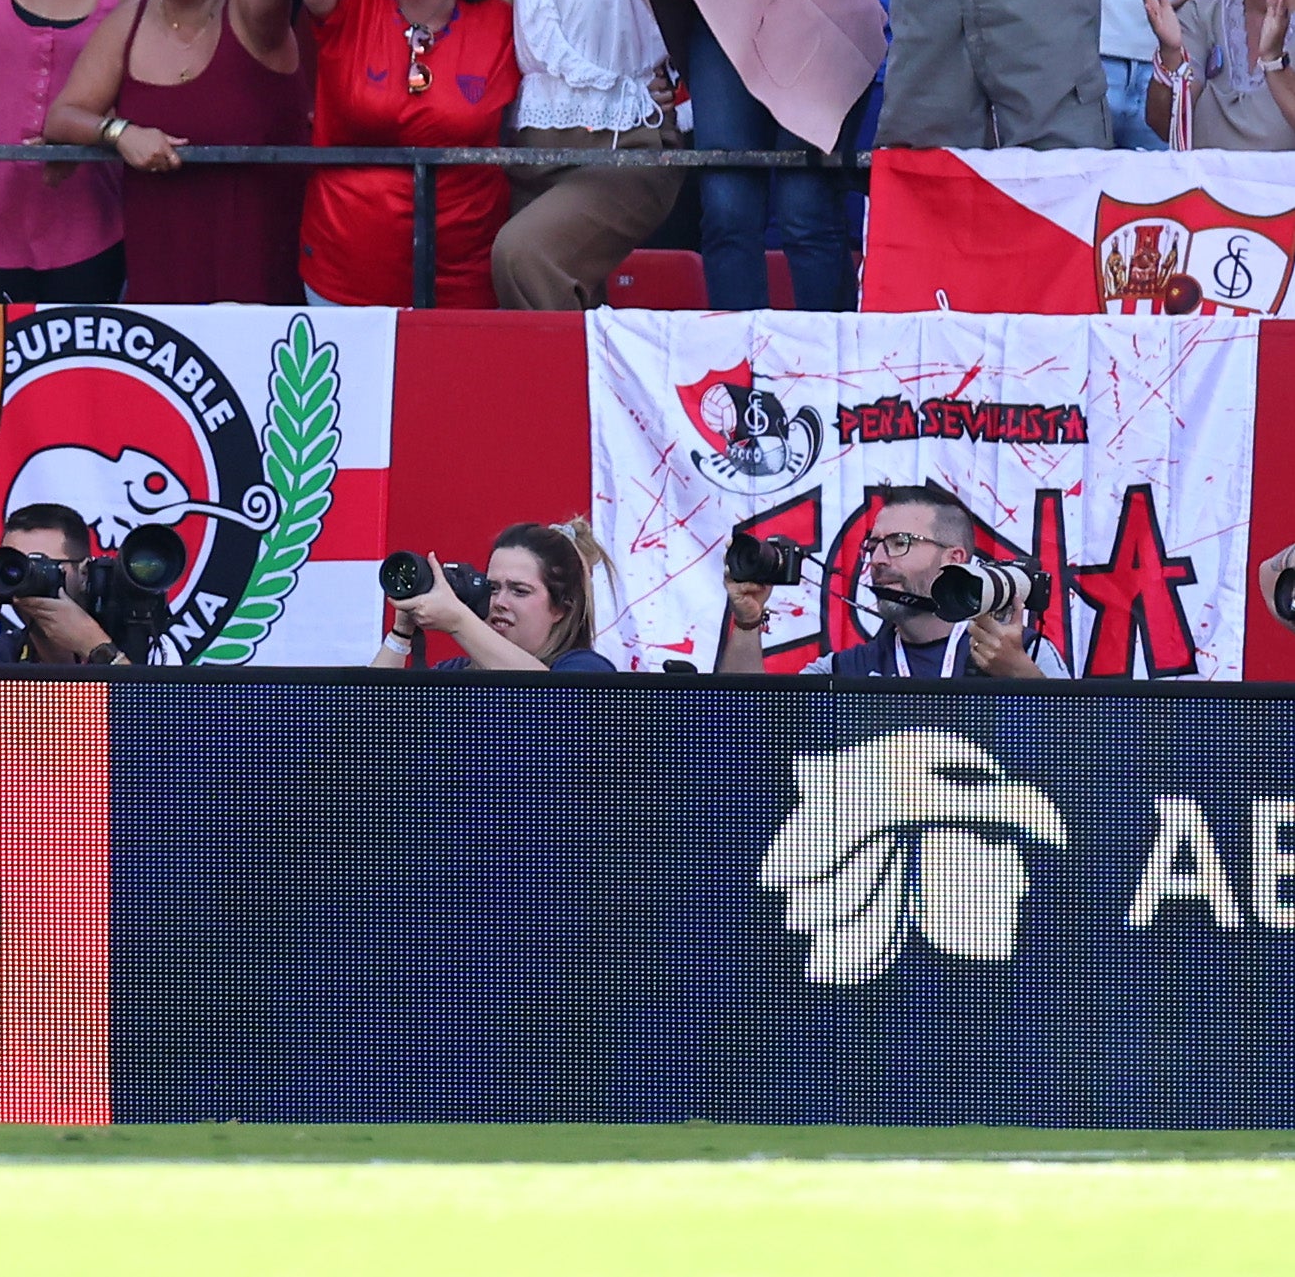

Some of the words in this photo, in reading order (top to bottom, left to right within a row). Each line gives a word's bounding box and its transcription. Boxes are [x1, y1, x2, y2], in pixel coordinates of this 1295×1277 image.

[5, 316, 236, 433] SUPERCABLE
[839, 395, 919, 444] PEÑA
[922, 399, 1089, 444] SEVILLISTA
